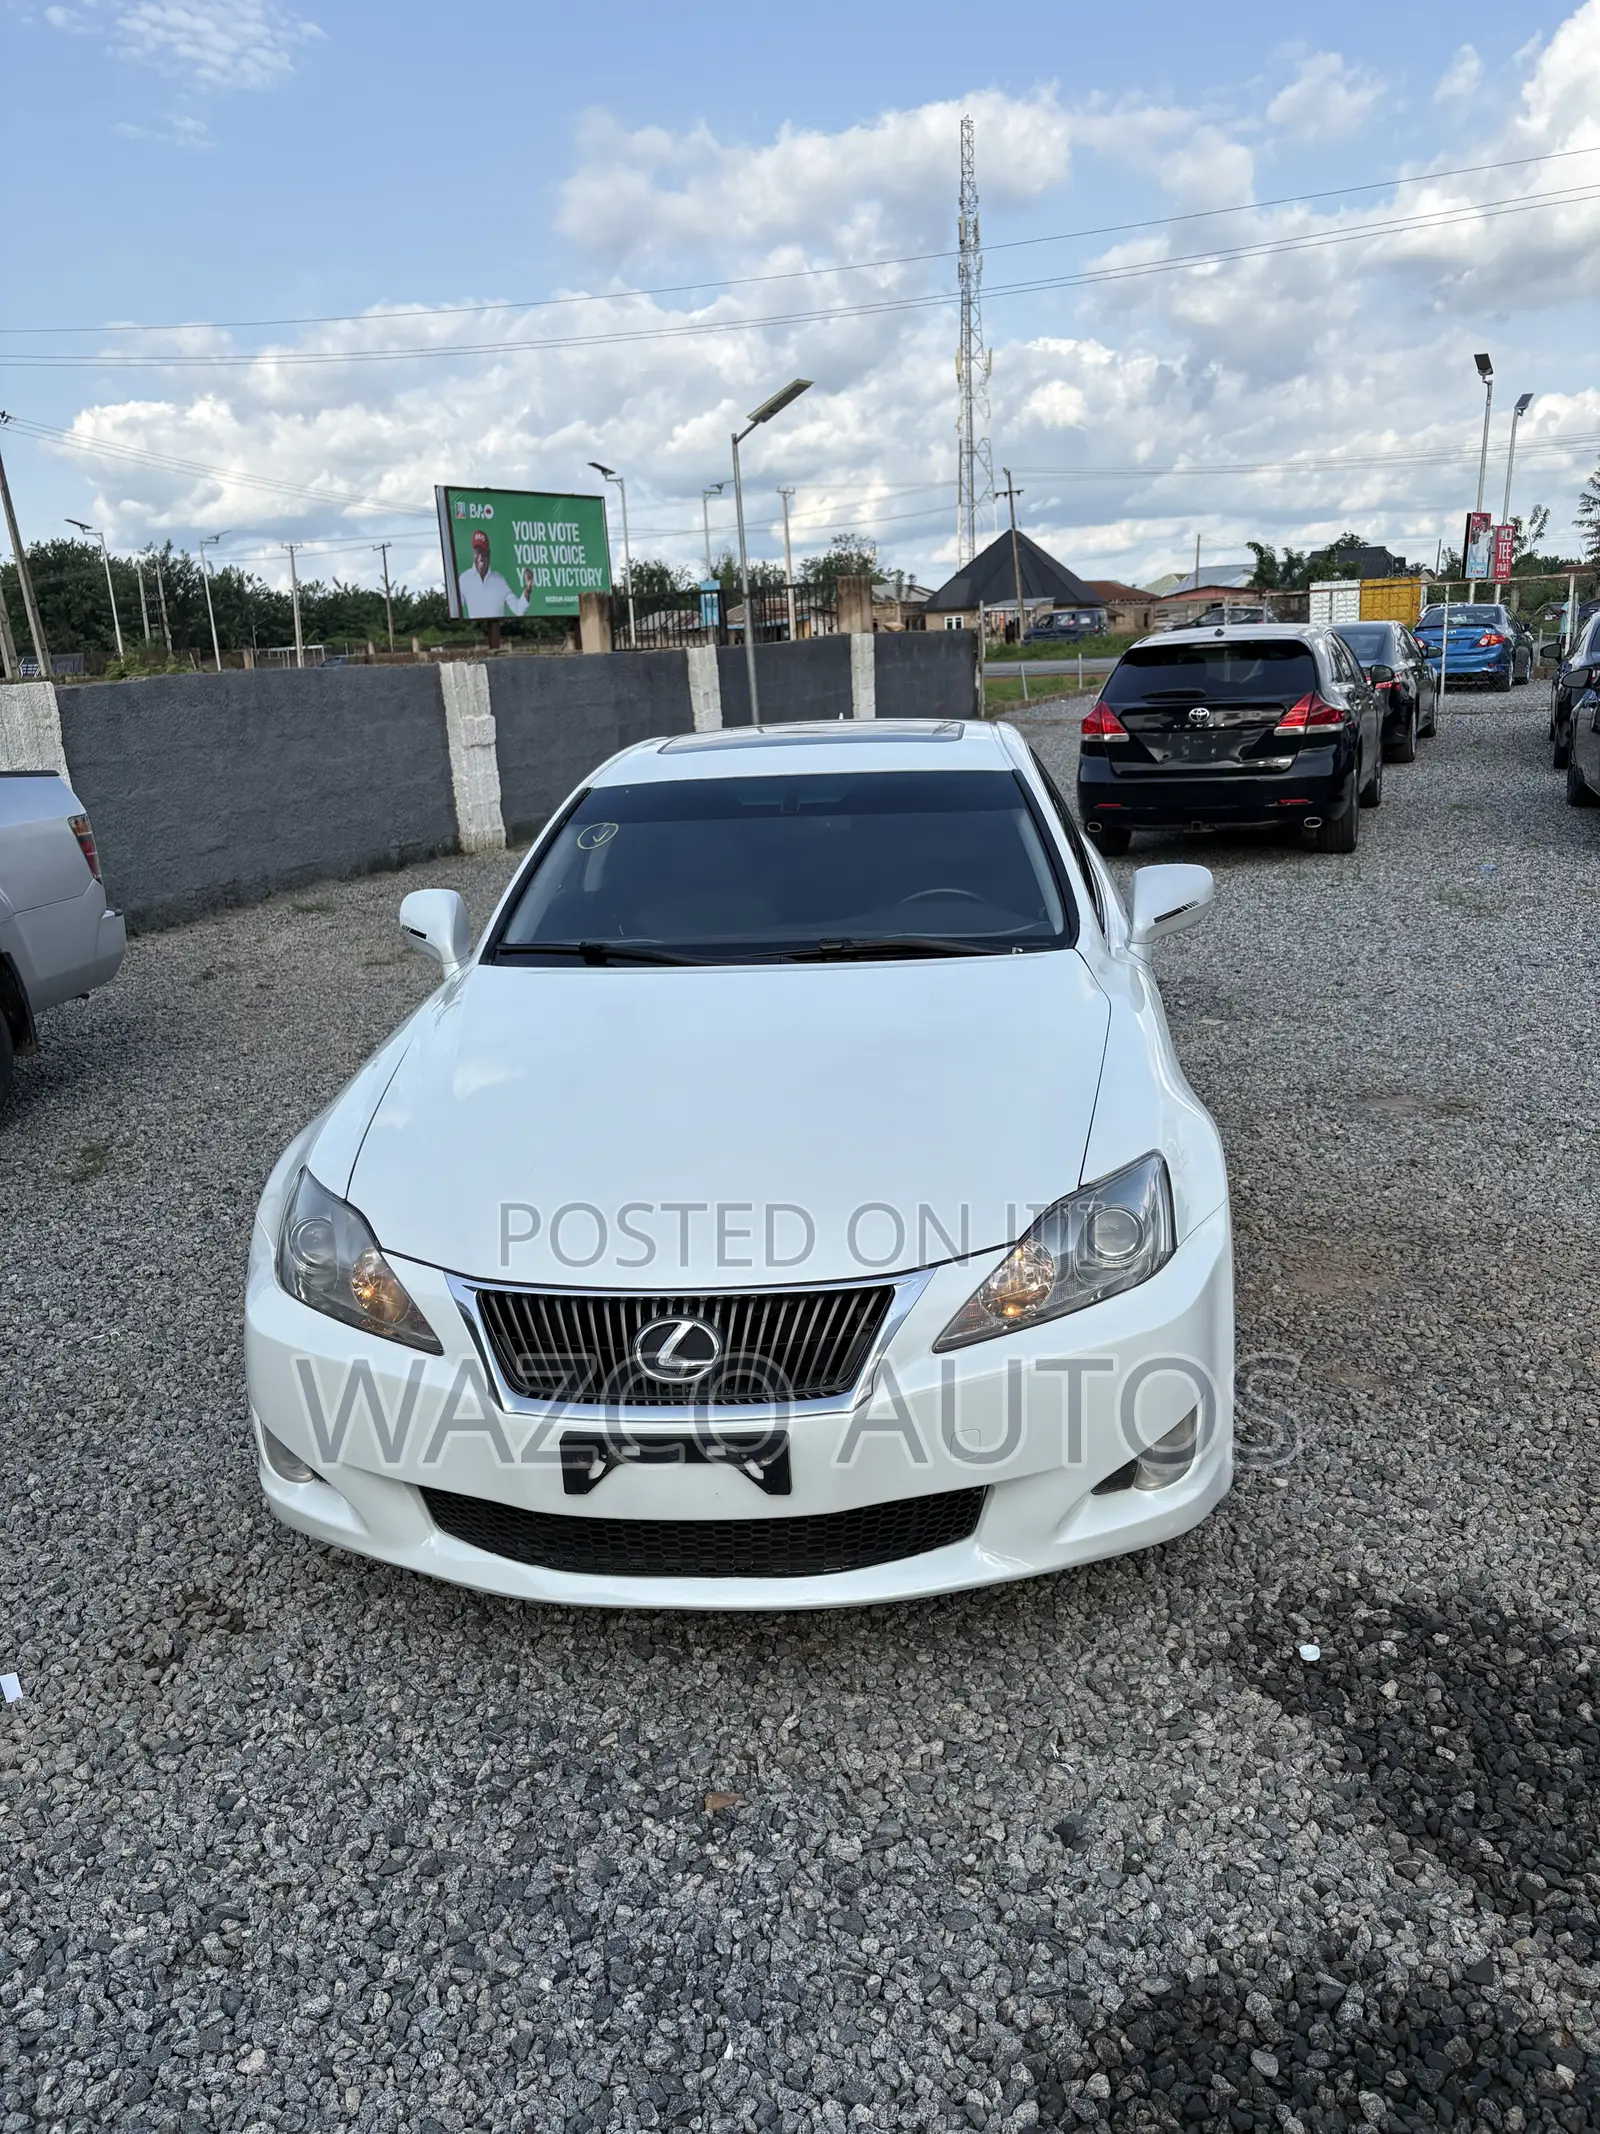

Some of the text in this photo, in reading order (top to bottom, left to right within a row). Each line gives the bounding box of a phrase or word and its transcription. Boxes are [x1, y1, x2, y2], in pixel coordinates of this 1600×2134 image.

[469, 503, 494, 519] BAO
[512, 521, 580, 542] YOUR VOTE
[514, 544, 586, 564] YOUR VOICE
[516, 567, 602, 587] YUR VICTORY
